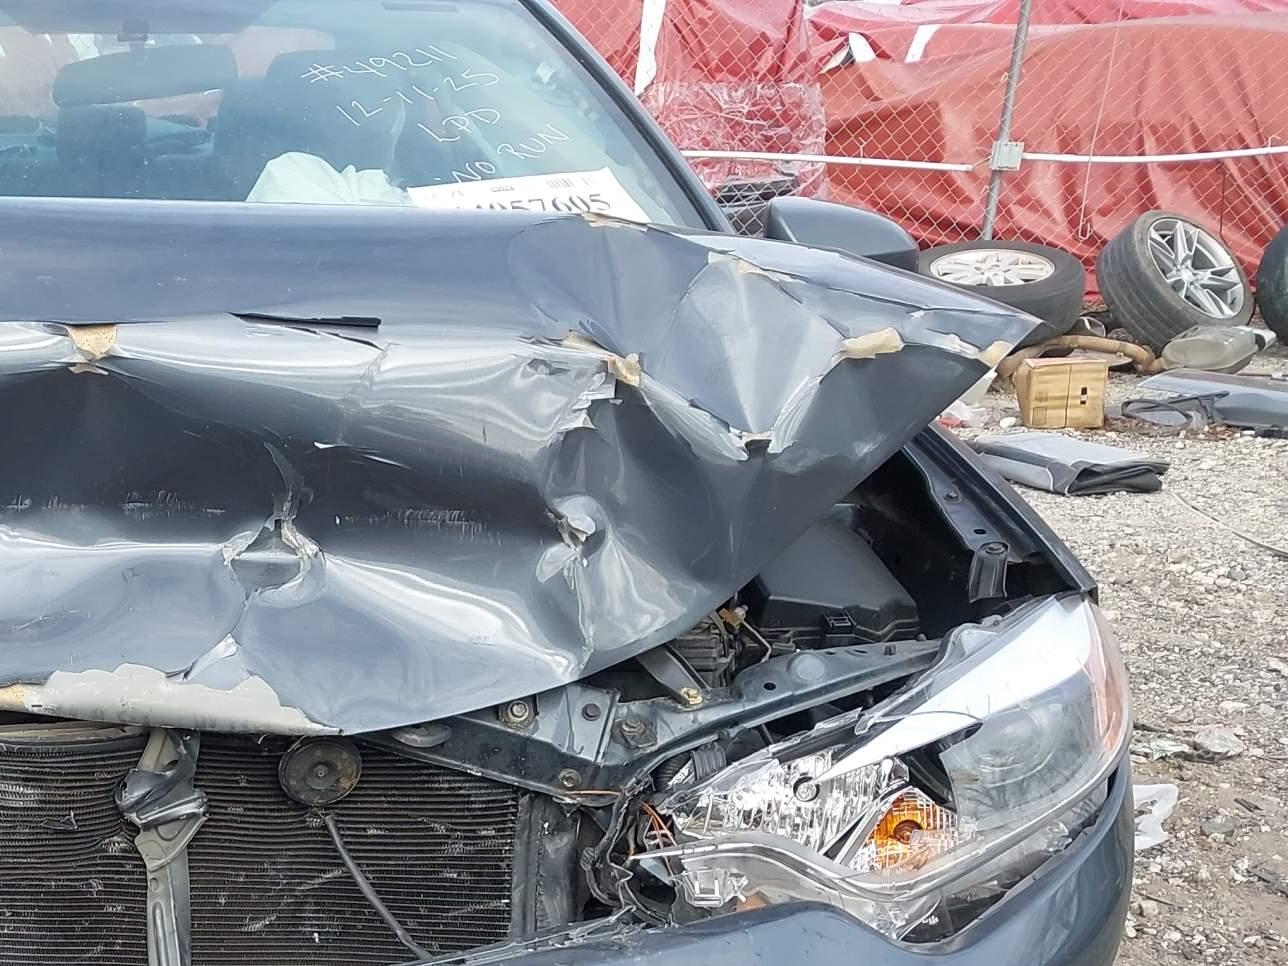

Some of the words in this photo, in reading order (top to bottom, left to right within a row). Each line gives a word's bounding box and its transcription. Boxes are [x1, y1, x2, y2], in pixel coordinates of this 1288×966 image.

[300, 45, 457, 83] #49211
[336, 69, 499, 126] 12-11-25
[496, 122, 570, 160] RUN
